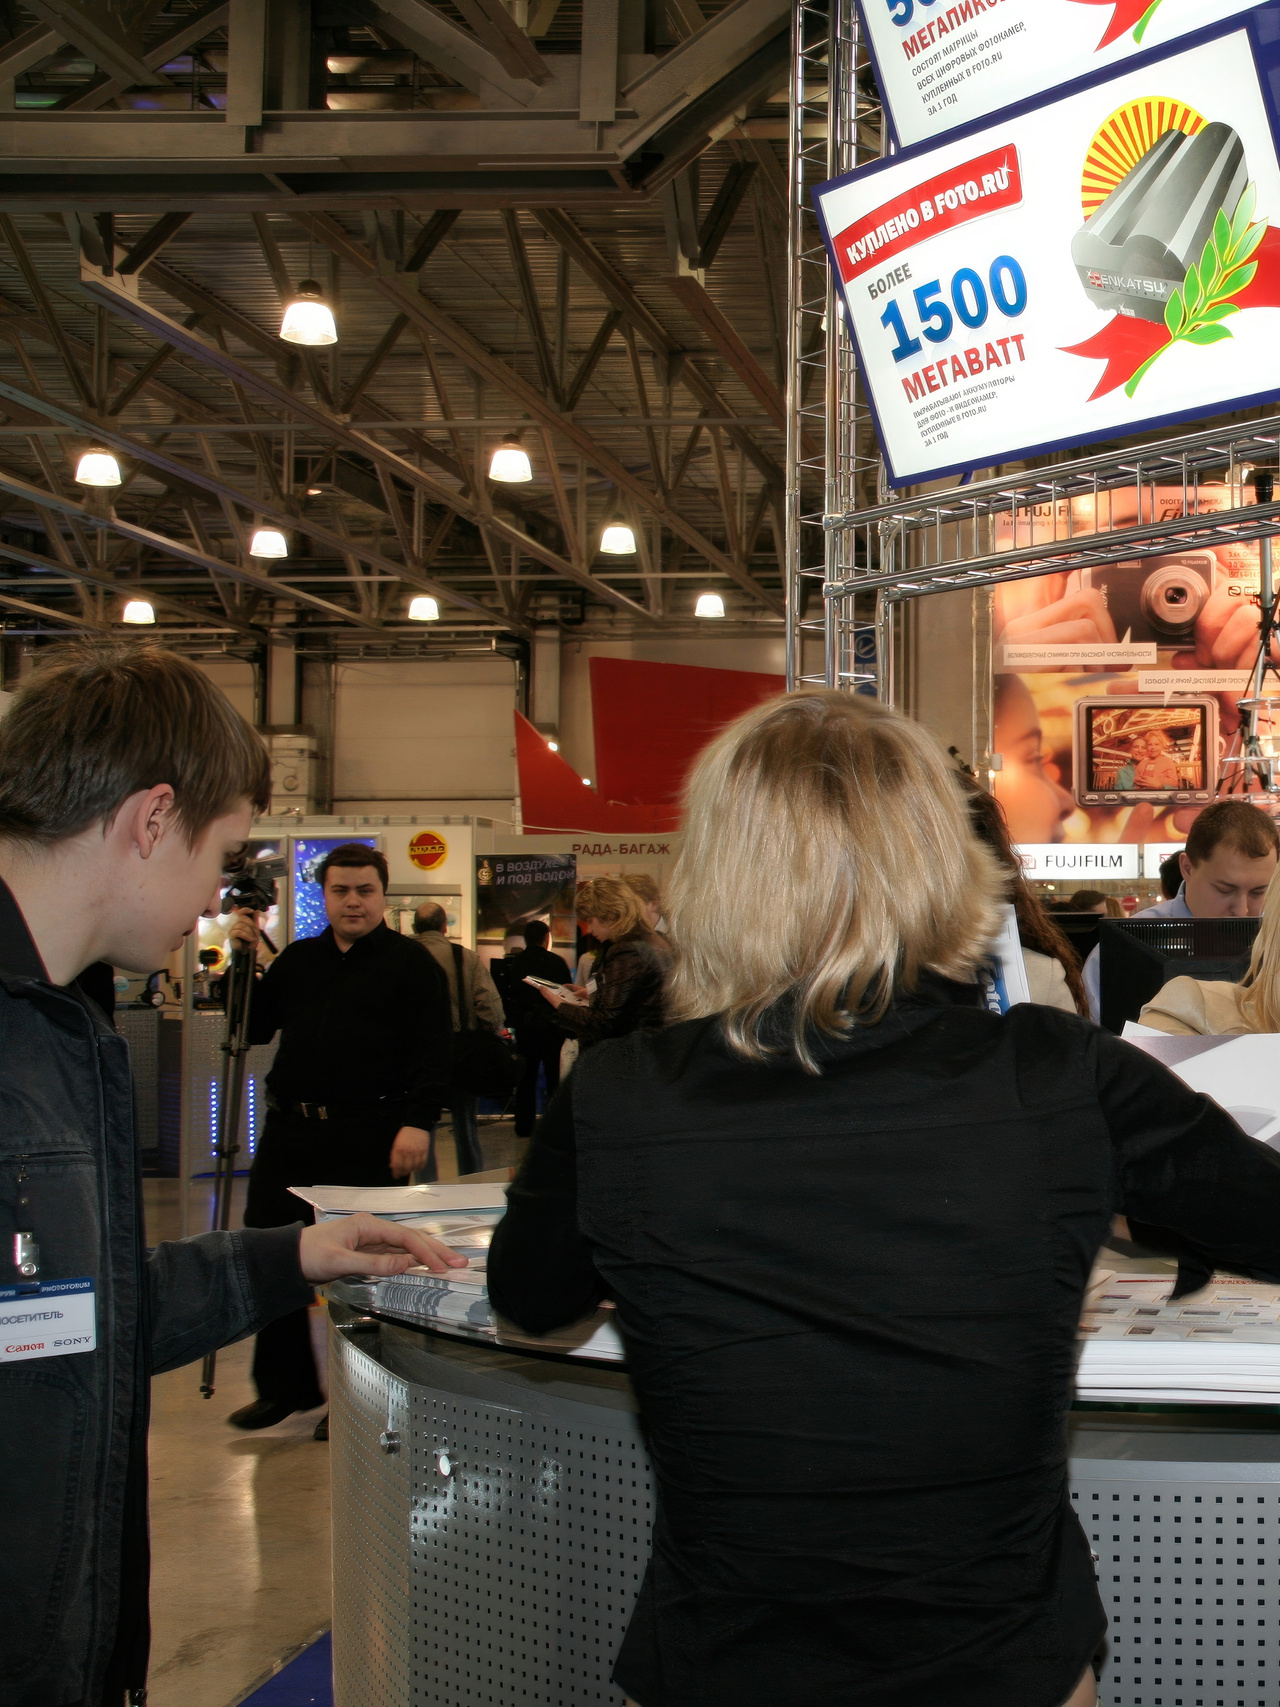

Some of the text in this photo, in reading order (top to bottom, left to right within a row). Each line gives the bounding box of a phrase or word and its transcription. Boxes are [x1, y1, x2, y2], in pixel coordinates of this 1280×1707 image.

[911, 29, 979, 77] СОСТОЯТ МАТРИЦЫ
[916, 72, 936, 91] ВСЕХ
[936, 47, 979, 80] ЦИФРОВЫХ
[921, 50, 1003, 104] КУПЛЕННЫХ В FOTO.RU
[927, 93, 959, 117] ЗА 1 ГОД
[846, 169, 1011, 266] КУПЛЕНО В FOTO.RU
[867, 262, 913, 301] БОЛЕЕ
[1100, 274, 1167, 295] ENKATSU
[880, 255, 1028, 364] 1500
[901, 333, 1026, 404] МЕГАВАТТ
[572, 843, 671, 856] РАДА-БАГАЖ
[1046, 855, 1123, 868] FUJIFILM
[495, 863, 504, 873] В
[496, 868, 576, 885] И ПОД ВОДОЙ
[5, 1336, 92, 1354] Canon SONY
